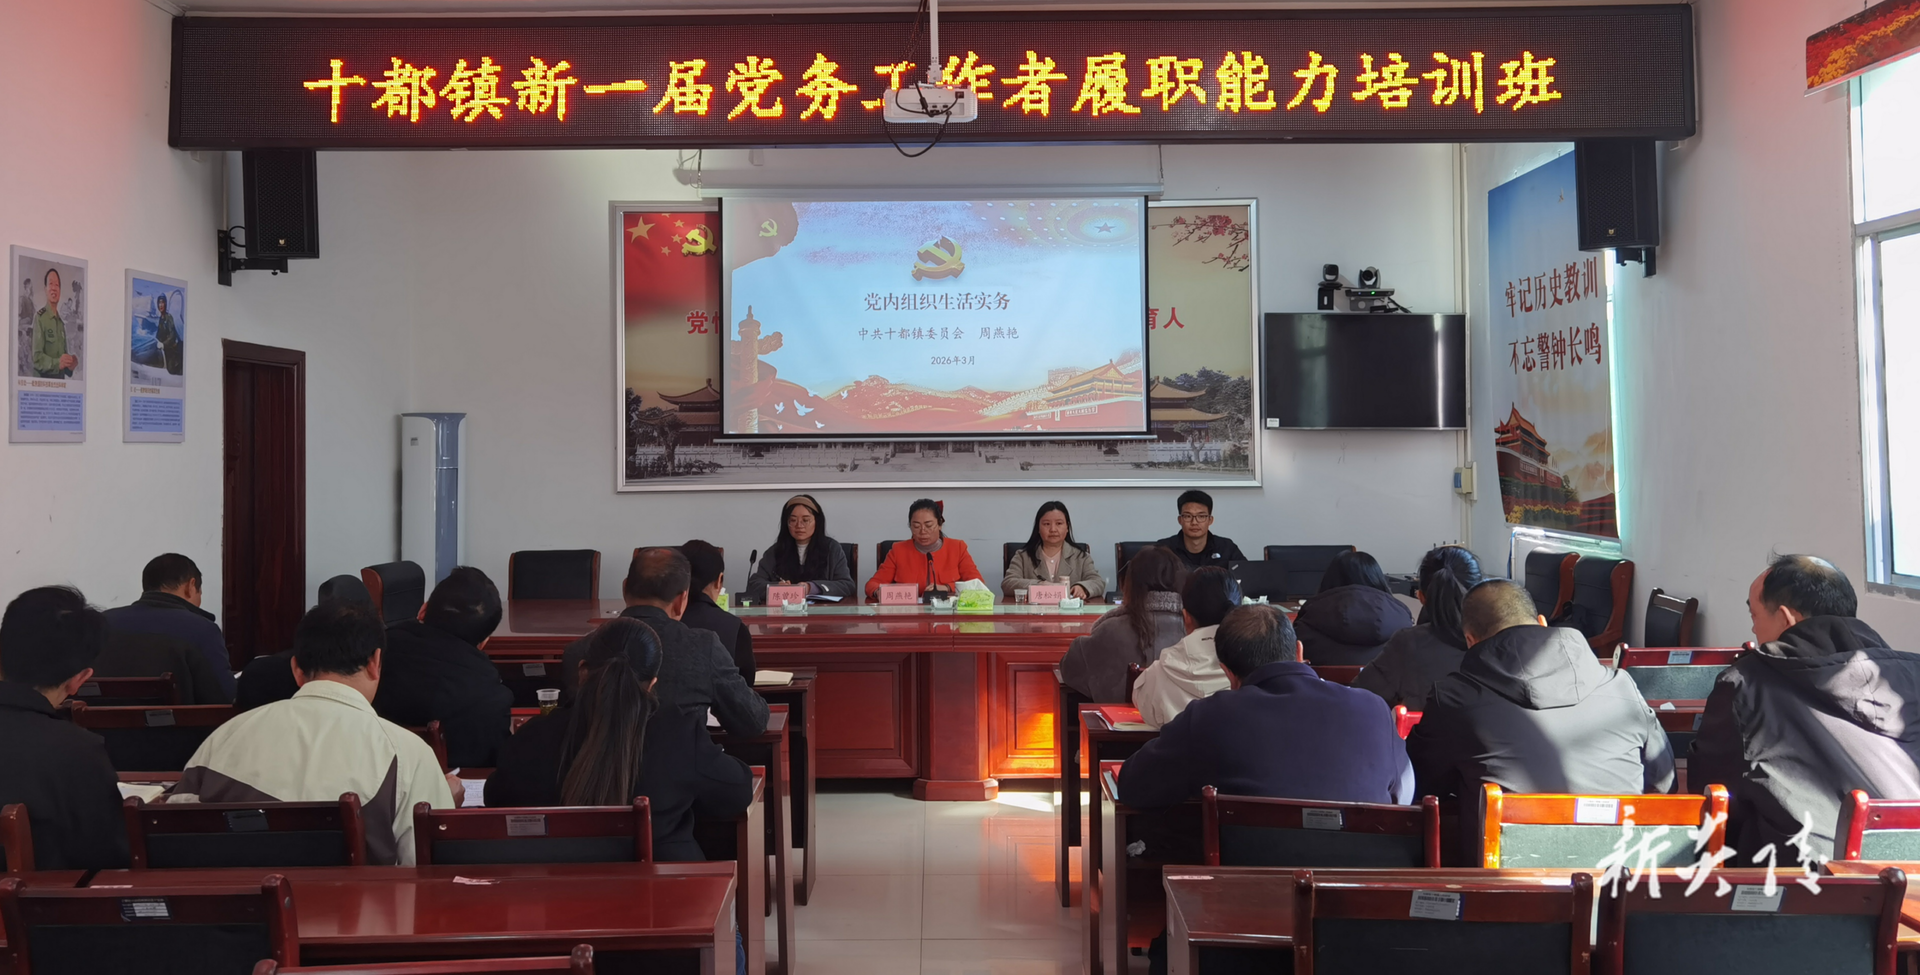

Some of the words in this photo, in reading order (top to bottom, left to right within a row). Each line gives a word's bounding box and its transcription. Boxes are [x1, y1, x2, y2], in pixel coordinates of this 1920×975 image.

[1505, 256, 1598, 318] 牢记历史教训
[864, 291, 1011, 311] 党内组织生活实务
[858, 326, 965, 341] 中共十都镇委员会
[978, 326, 1020, 340] 周燕艳
[1508, 322, 1601, 375] 不忘警钟长鸣
[930, 355, 975, 366] 2026年3月
